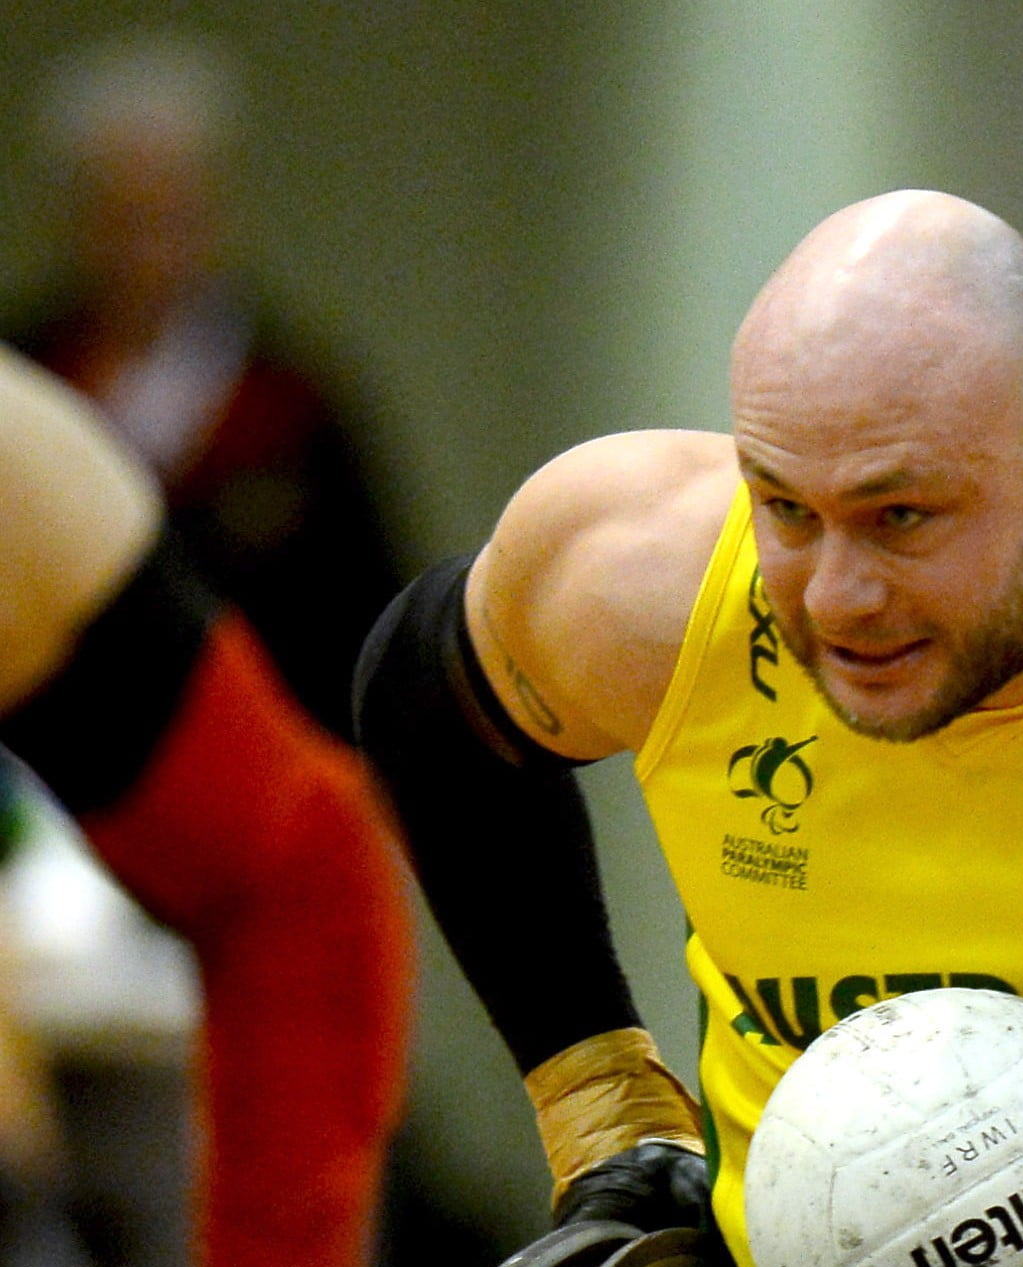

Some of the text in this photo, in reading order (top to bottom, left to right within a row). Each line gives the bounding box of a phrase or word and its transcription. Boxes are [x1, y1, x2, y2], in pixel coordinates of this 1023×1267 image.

[721, 847, 807, 876] PARALYMPIC
[722, 833, 808, 861] AUSTRALIAN
[721, 860, 809, 891] COMMITTEE
[943, 1118, 1018, 1177] IWRF
